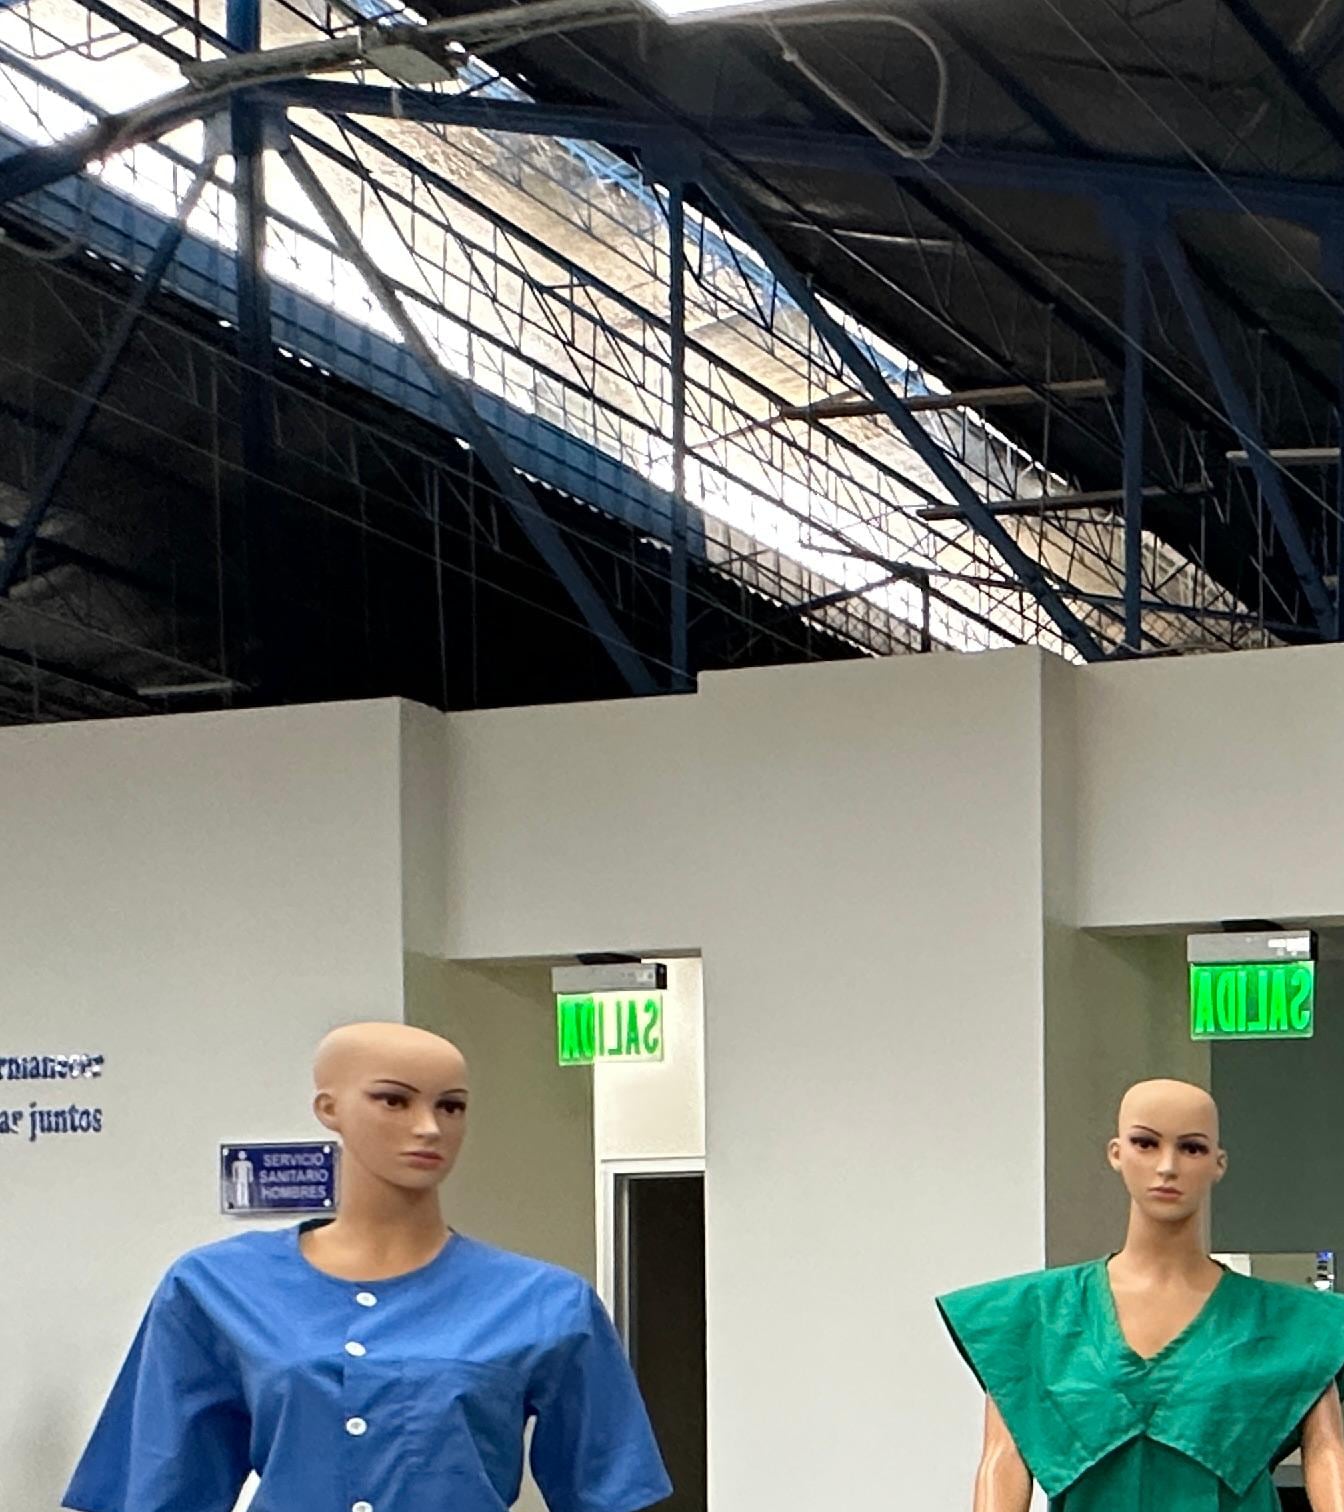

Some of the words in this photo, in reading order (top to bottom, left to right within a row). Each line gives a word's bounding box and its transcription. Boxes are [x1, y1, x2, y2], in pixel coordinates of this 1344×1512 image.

[29, 1101, 102, 1142] juntos
[263, 1152, 324, 1168] SERVICIO
[259, 1168, 329, 1183] SANITARIO
